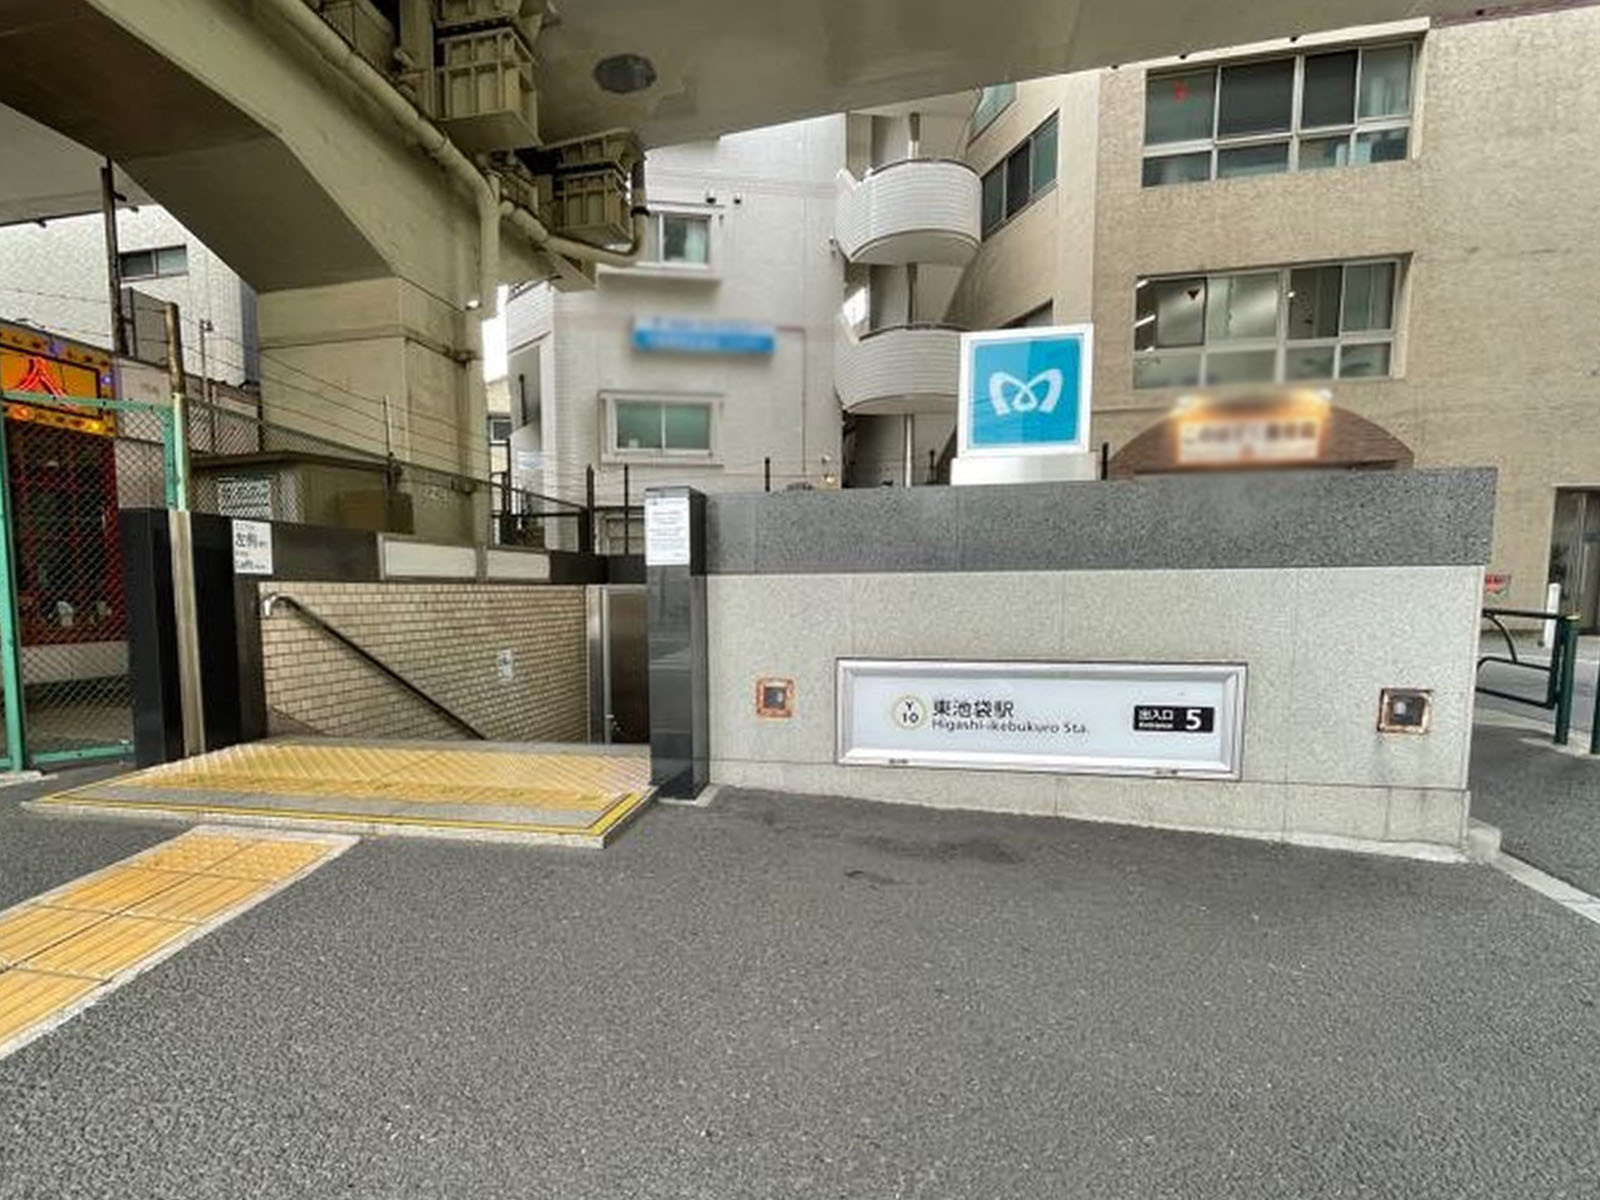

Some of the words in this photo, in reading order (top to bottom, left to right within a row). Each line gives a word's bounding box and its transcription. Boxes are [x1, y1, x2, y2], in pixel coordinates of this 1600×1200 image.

[905, 701, 914, 711] Y
[931, 699, 1015, 718] 東池袋駅
[902, 712, 919, 724] 10
[1138, 709, 1174, 721] 出入口
[1185, 708, 1202, 731] 5
